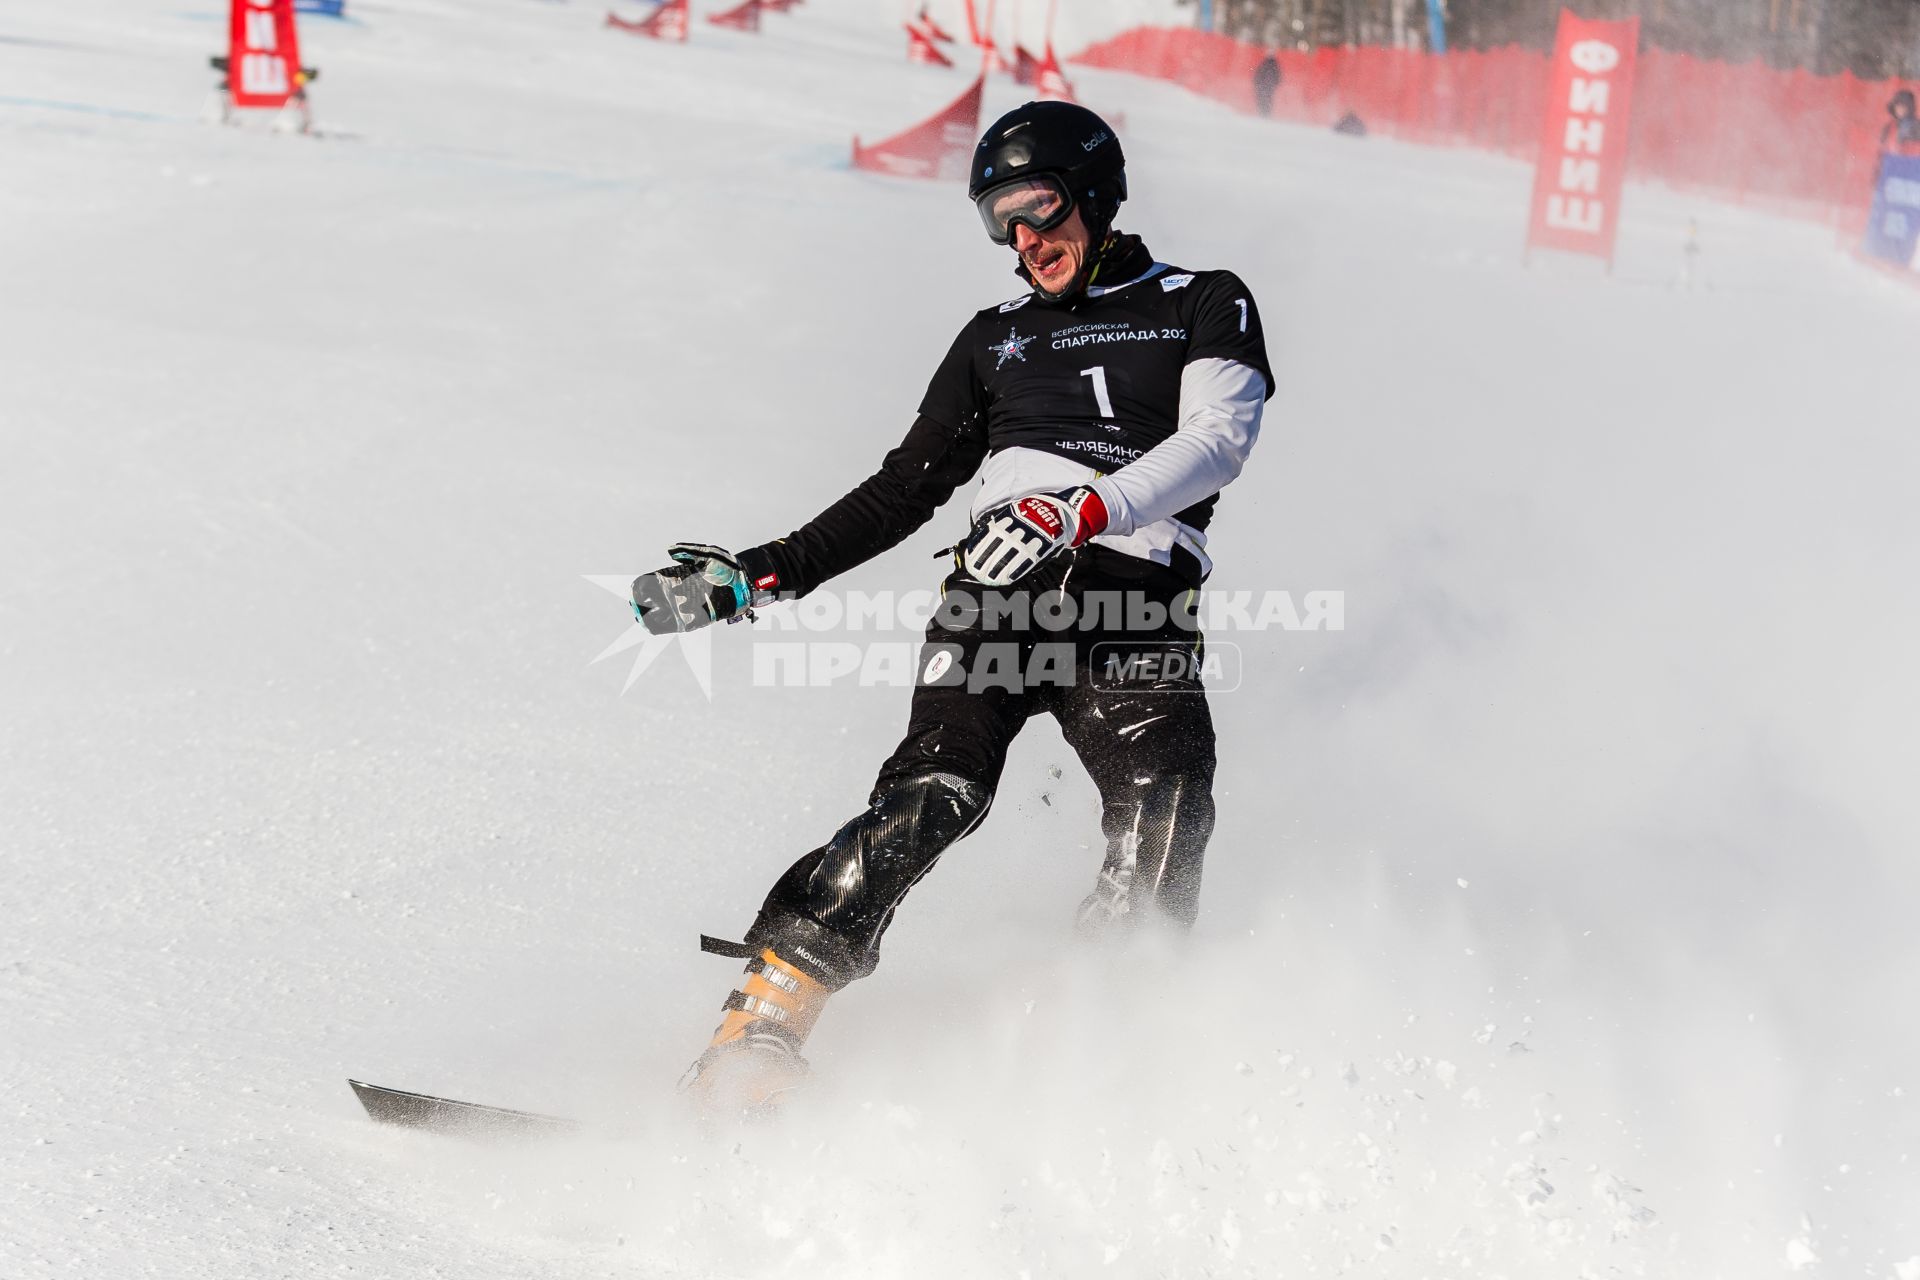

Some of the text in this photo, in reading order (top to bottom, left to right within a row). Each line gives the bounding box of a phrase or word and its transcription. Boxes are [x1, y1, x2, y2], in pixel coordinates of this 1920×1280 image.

[1547, 39, 1620, 235] ФИНИШ
[1051, 322, 1130, 338] ВСЕРОССИЙСКАЯ
[1234, 298, 1247, 333] 1
[1051, 329, 1159, 350] СПАРТАКИАДА
[1080, 366, 1115, 418] 1
[1055, 441, 1147, 460] ЧЕЛЯБИНС
[1026, 498, 1061, 528] LUDIS
